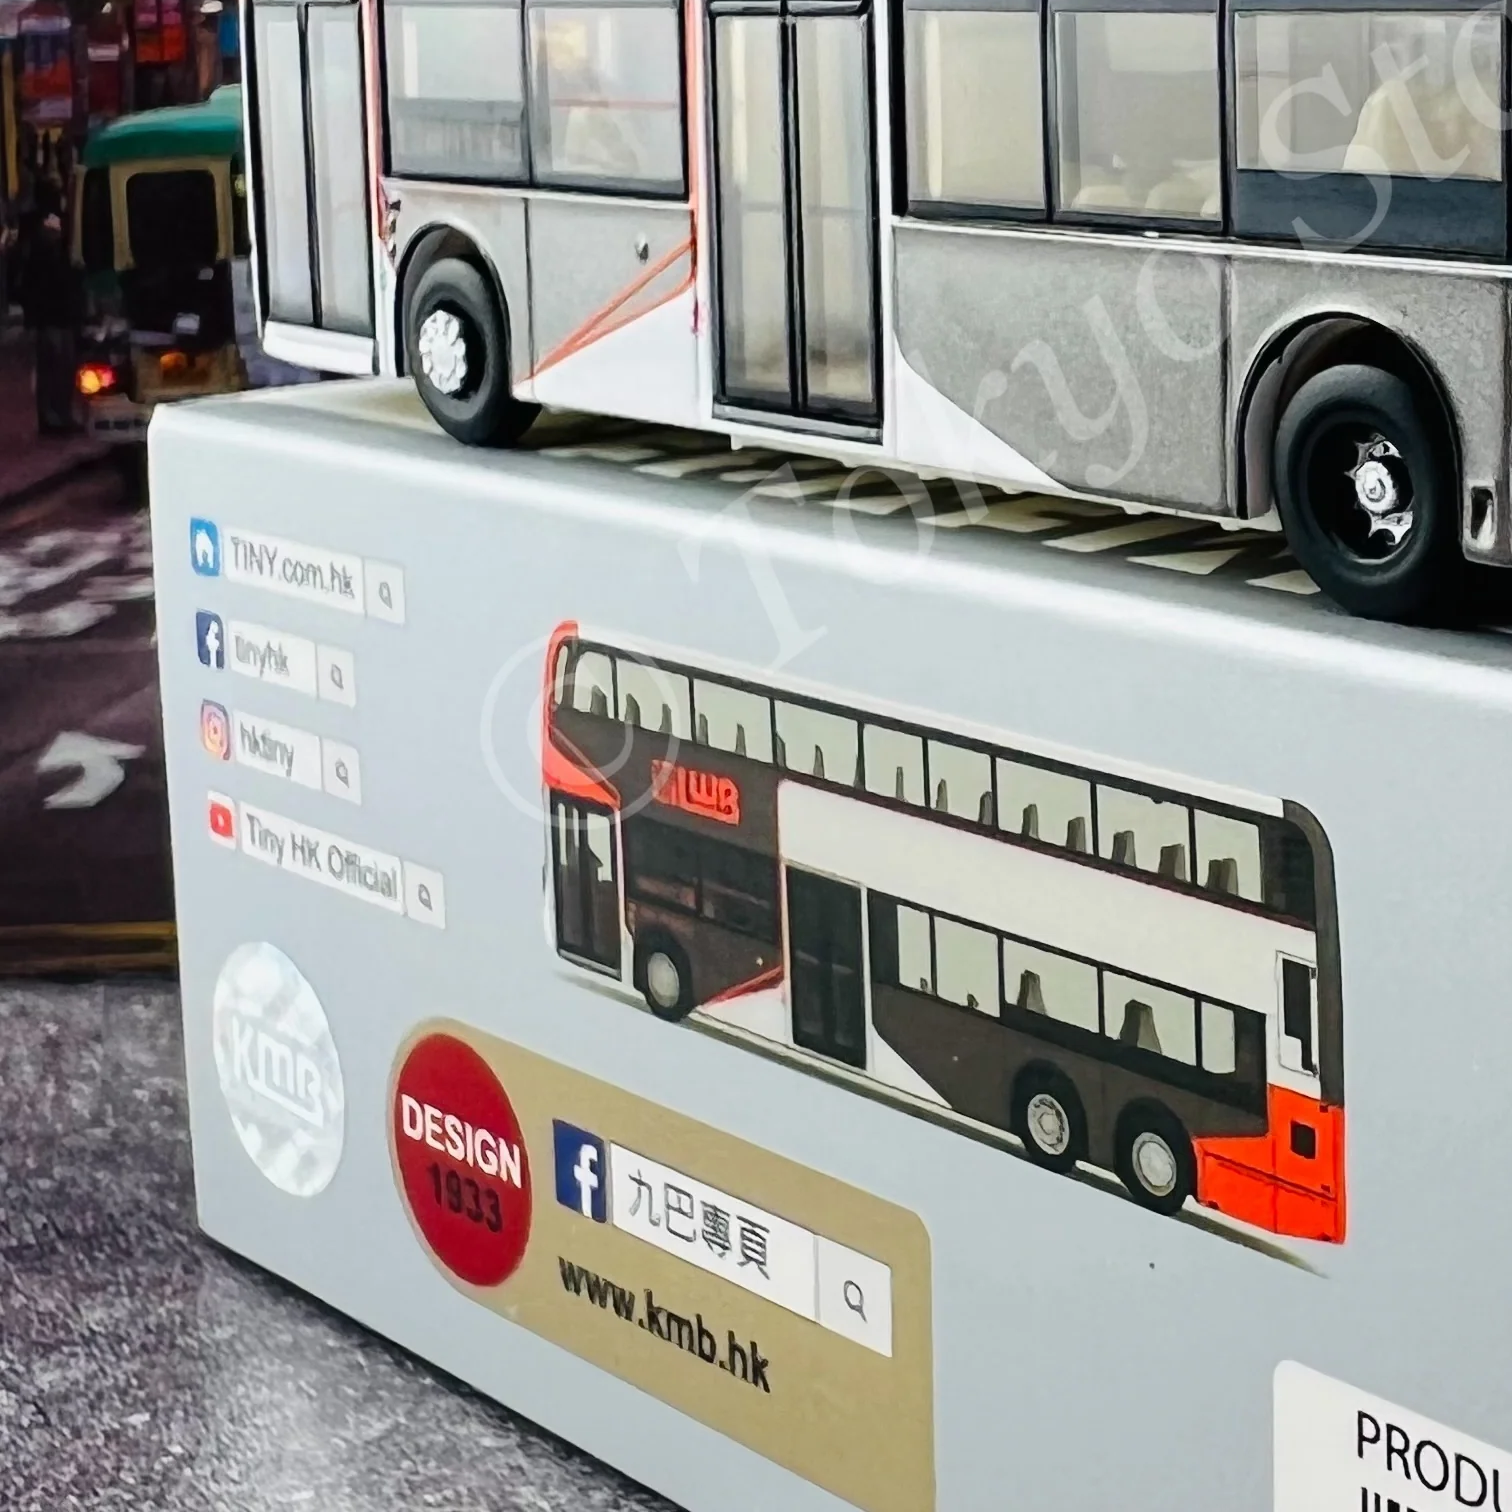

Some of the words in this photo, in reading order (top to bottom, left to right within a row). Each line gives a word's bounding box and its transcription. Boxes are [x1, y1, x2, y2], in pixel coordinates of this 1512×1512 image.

[230, 536, 356, 599] TINY.com.hk
[677, 765, 740, 826] LWB
[246, 811, 285, 865] Tiny
[290, 831, 322, 872] HK
[327, 844, 398, 901] Official
[401, 1093, 522, 1189] DESIGN
[628, 1169, 770, 1280] 九巴專頁
[557, 1255, 771, 1394] www.kmb.hk
